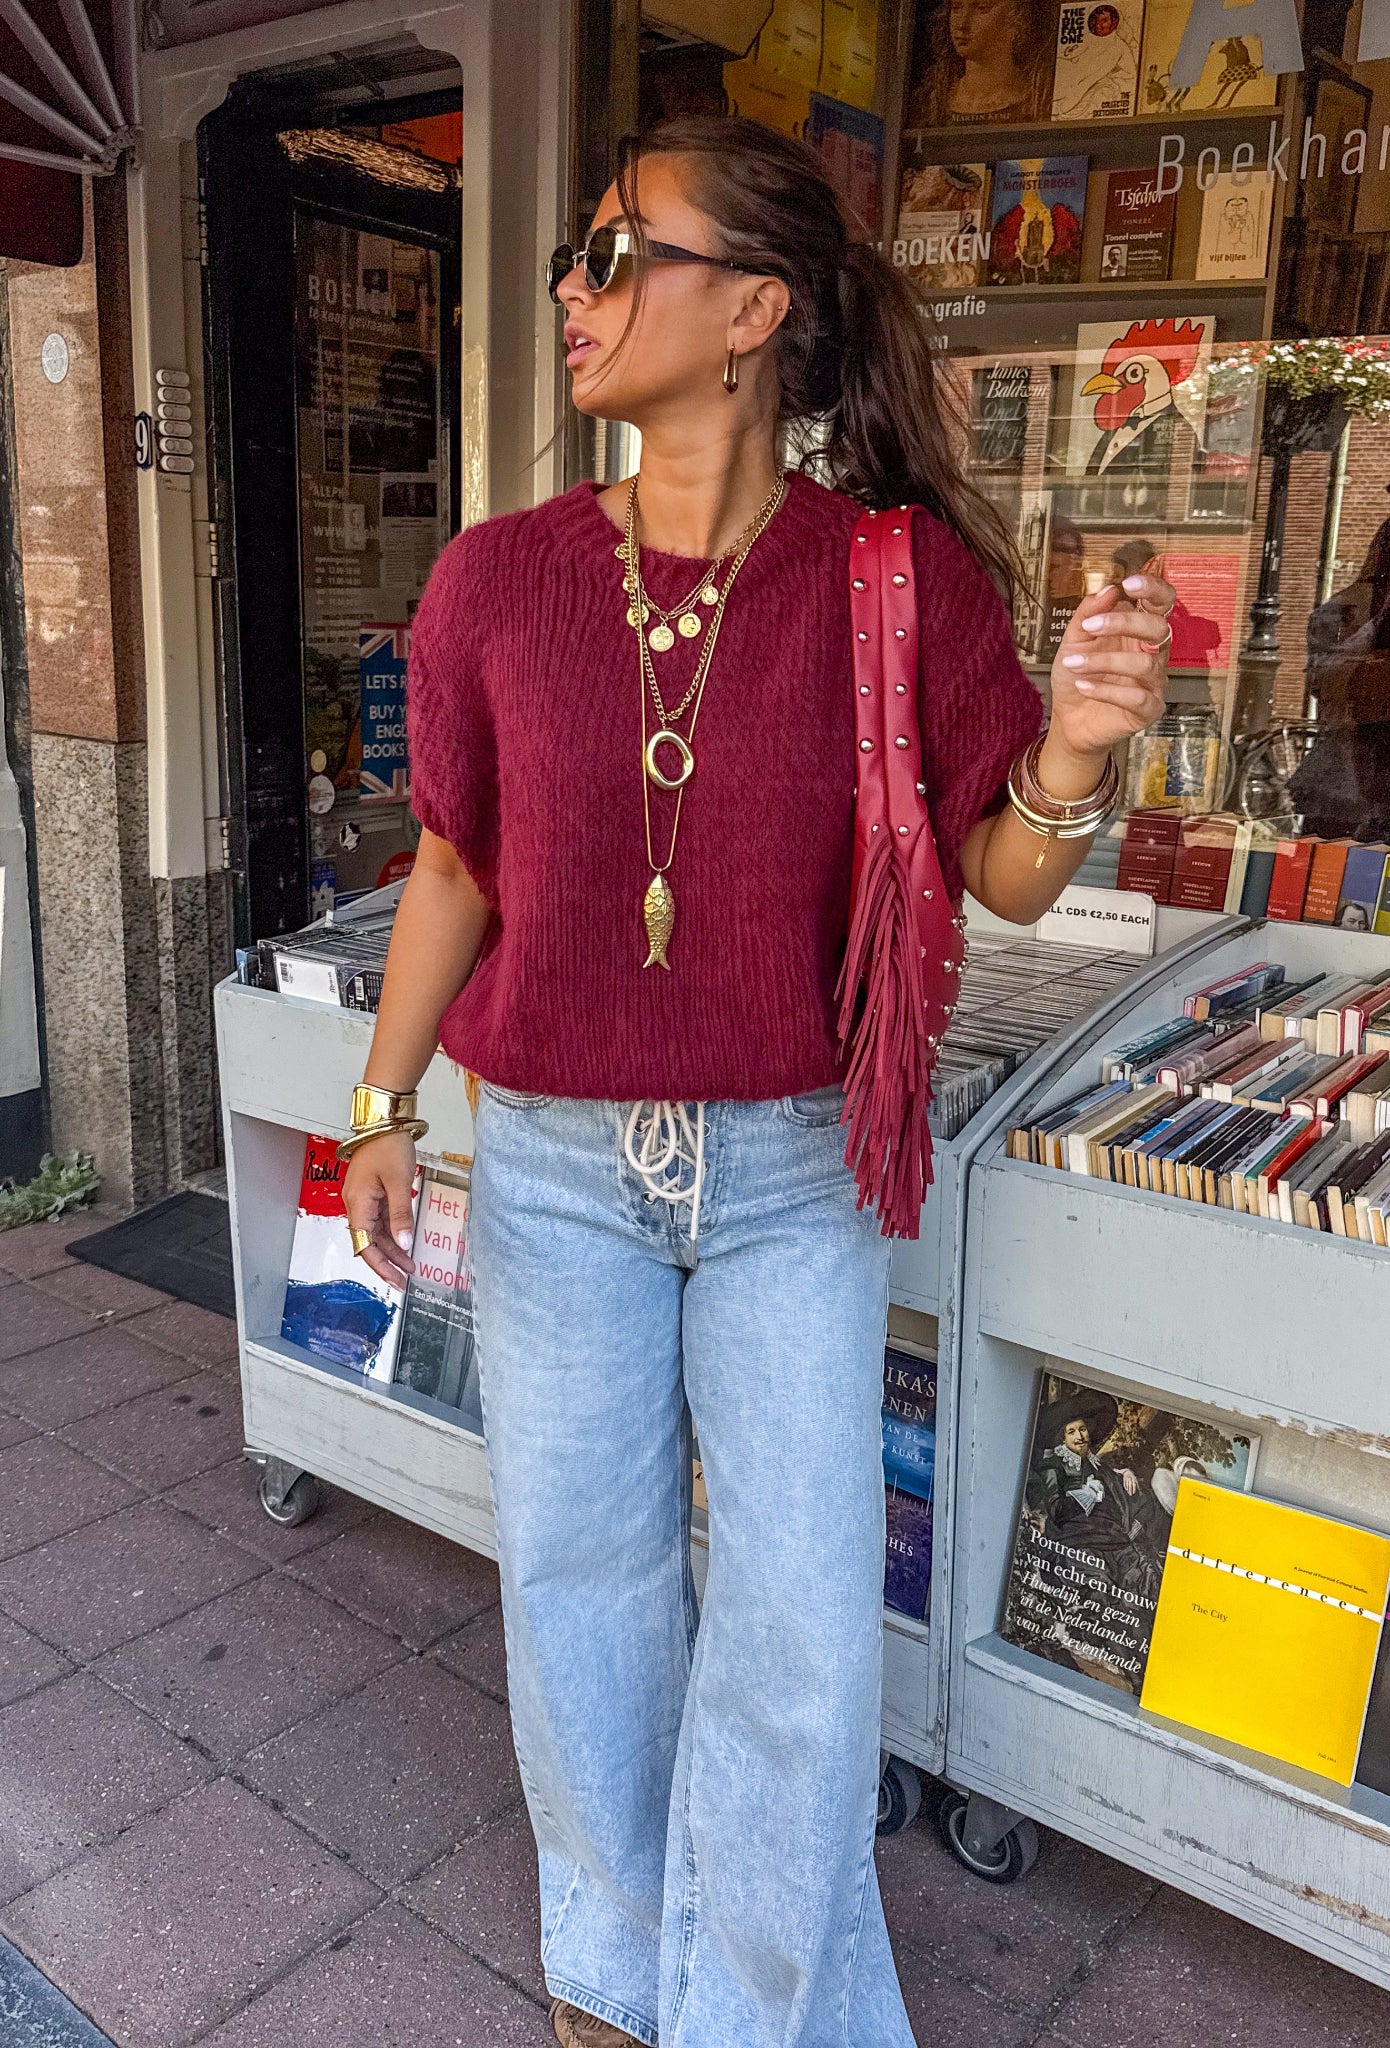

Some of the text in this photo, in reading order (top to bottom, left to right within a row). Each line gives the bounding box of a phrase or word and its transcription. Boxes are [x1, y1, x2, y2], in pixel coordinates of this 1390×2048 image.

[1061, 17, 1085, 27] BIG
[1062, 7, 1086, 18] THE
[1060, 34, 1084, 45] ONE
[1061, 26, 1084, 36] FAT
[1003, 177, 1078, 192] MONSTERBOEK
[1104, 232, 1129, 242] Toneel
[892, 231, 992, 267] BOEKEN
[986, 361, 1031, 380] James
[985, 380, 1048, 398] Baldwin
[135, 419, 149, 465] 9
[365, 674, 398, 690] LET'S
[368, 704, 397, 720] BUY
[362, 743, 406, 760] BOOKS
[1065, 907, 1088, 917] CDS
[1089, 910, 1119, 921] €2,50
[1120, 913, 1150, 926] EACH
[428, 1190, 460, 1220] Het
[423, 1228, 467, 1256] van h
[885, 1365, 936, 1398] IKA'S
[905, 1430, 919, 1443] DE
[891, 1444, 927, 1465] KUNST
[885, 1535, 914, 1557] HES
[1029, 1524, 1107, 1571] Portretten
[1026, 1552, 1158, 1612] van echt en trouw
[1181, 1547, 1365, 1616] differences
[1022, 1570, 1141, 1629] Huwelijk en gezin
[1019, 1591, 1150, 1655] in de Nederlandse k
[1191, 1602, 1229, 1623] The City
[1016, 1615, 1142, 1674] van de zeventiende
